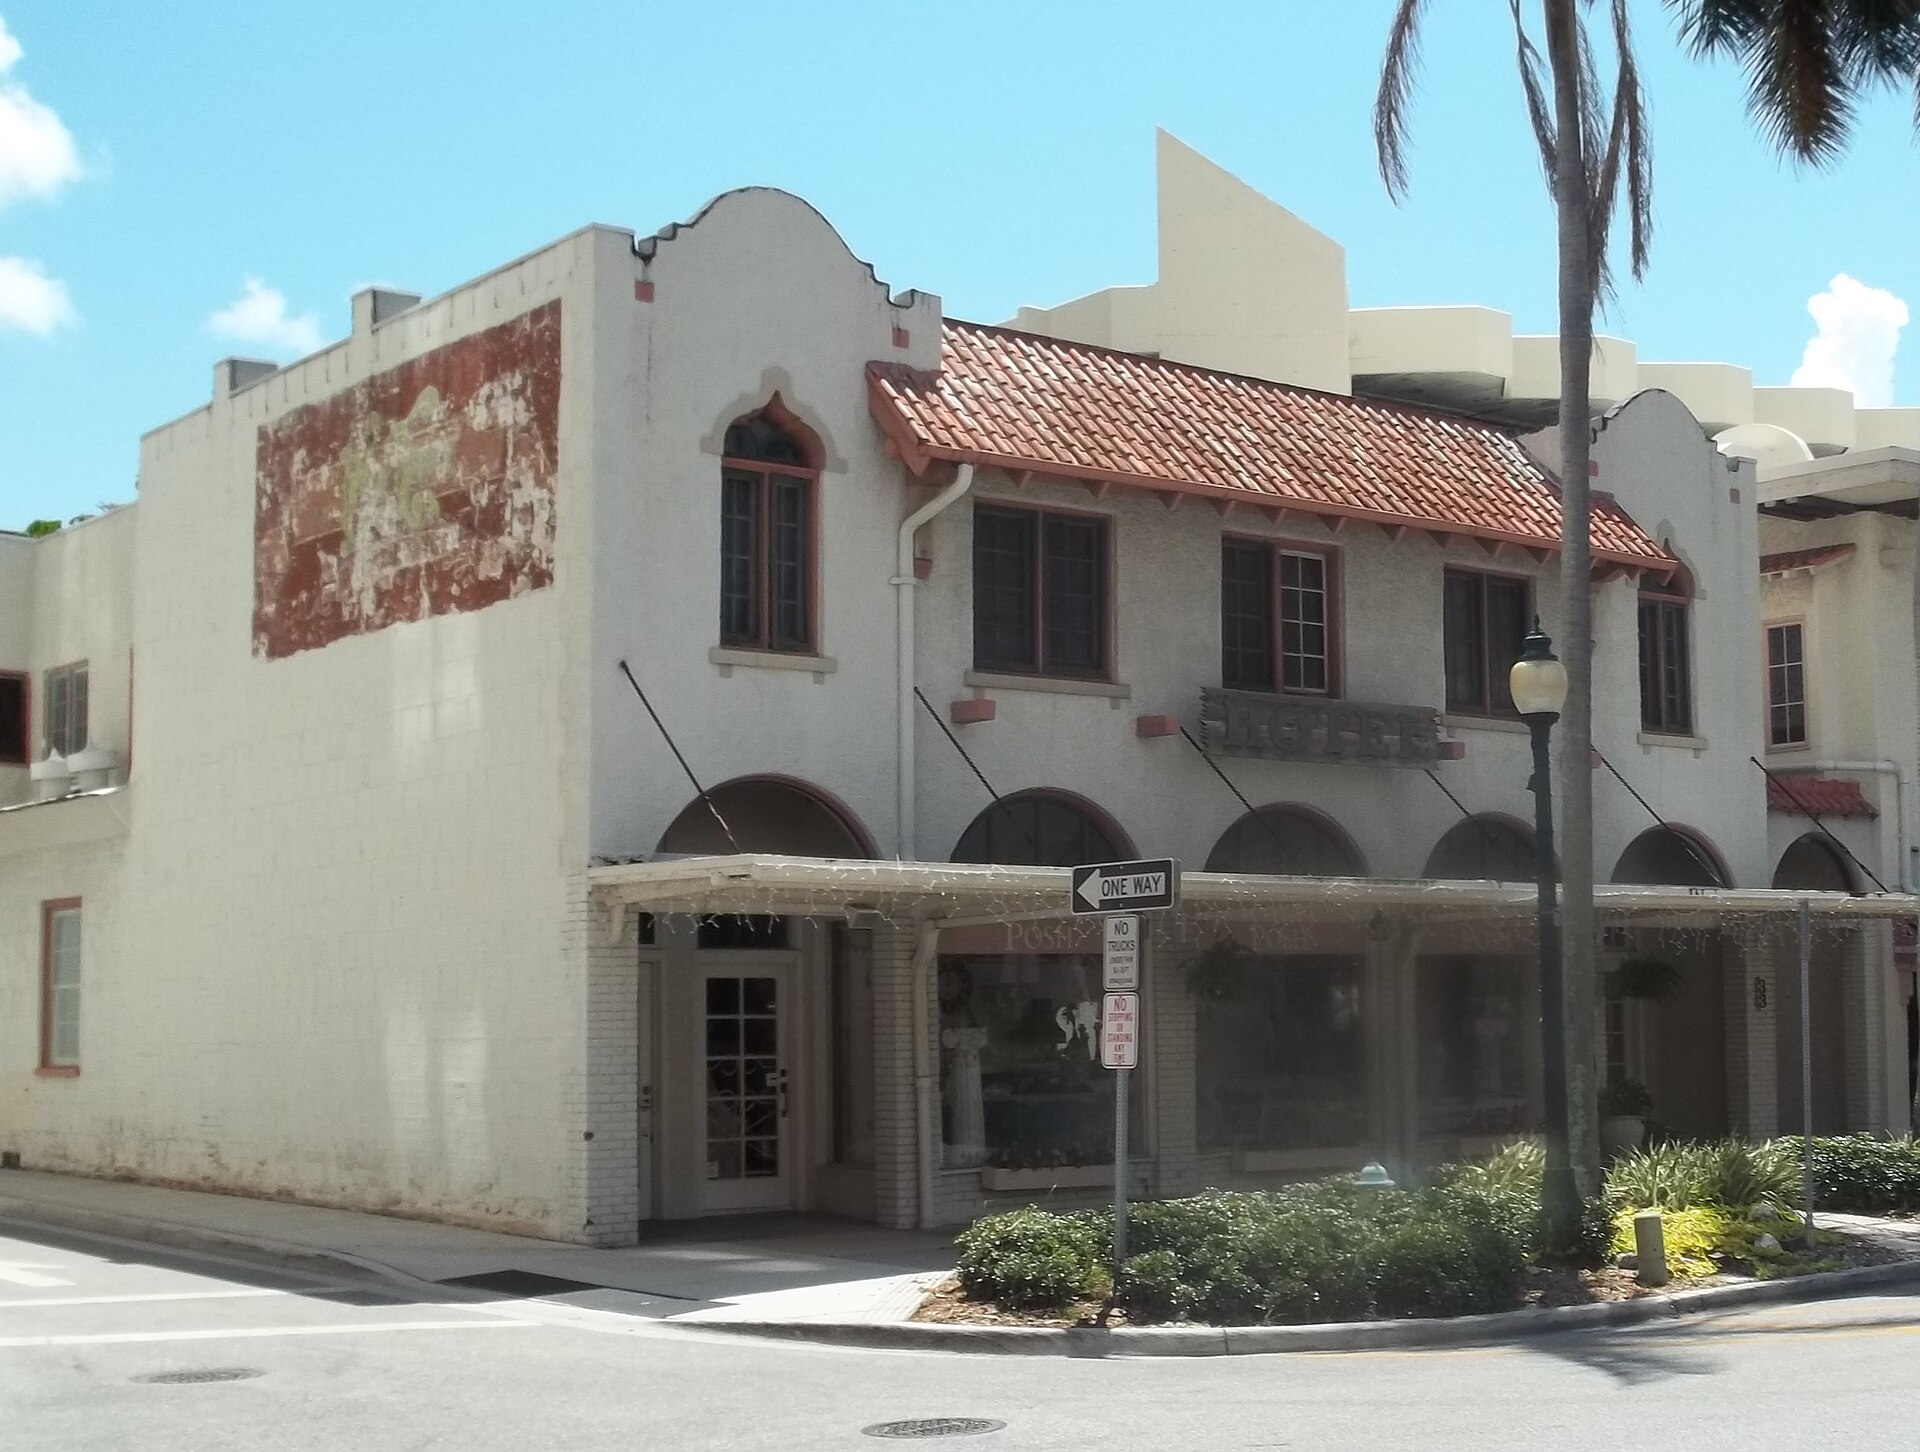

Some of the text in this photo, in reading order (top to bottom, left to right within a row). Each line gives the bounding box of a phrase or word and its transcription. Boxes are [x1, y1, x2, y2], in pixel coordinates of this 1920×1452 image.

[1223, 695, 1432, 759] HOTEL
[1101, 874, 1162, 898] ONE WAY
[1114, 921, 1129, 936] NO
[1108, 940, 1136, 952] TRUCKS
[1114, 998, 1127, 1012] NO
[1108, 1012, 1133, 1022] STOPPING
[1107, 1033, 1133, 1043] STANDING
[1114, 1044, 1125, 1053] ANY
[1113, 1053, 1126, 1064] TIME
